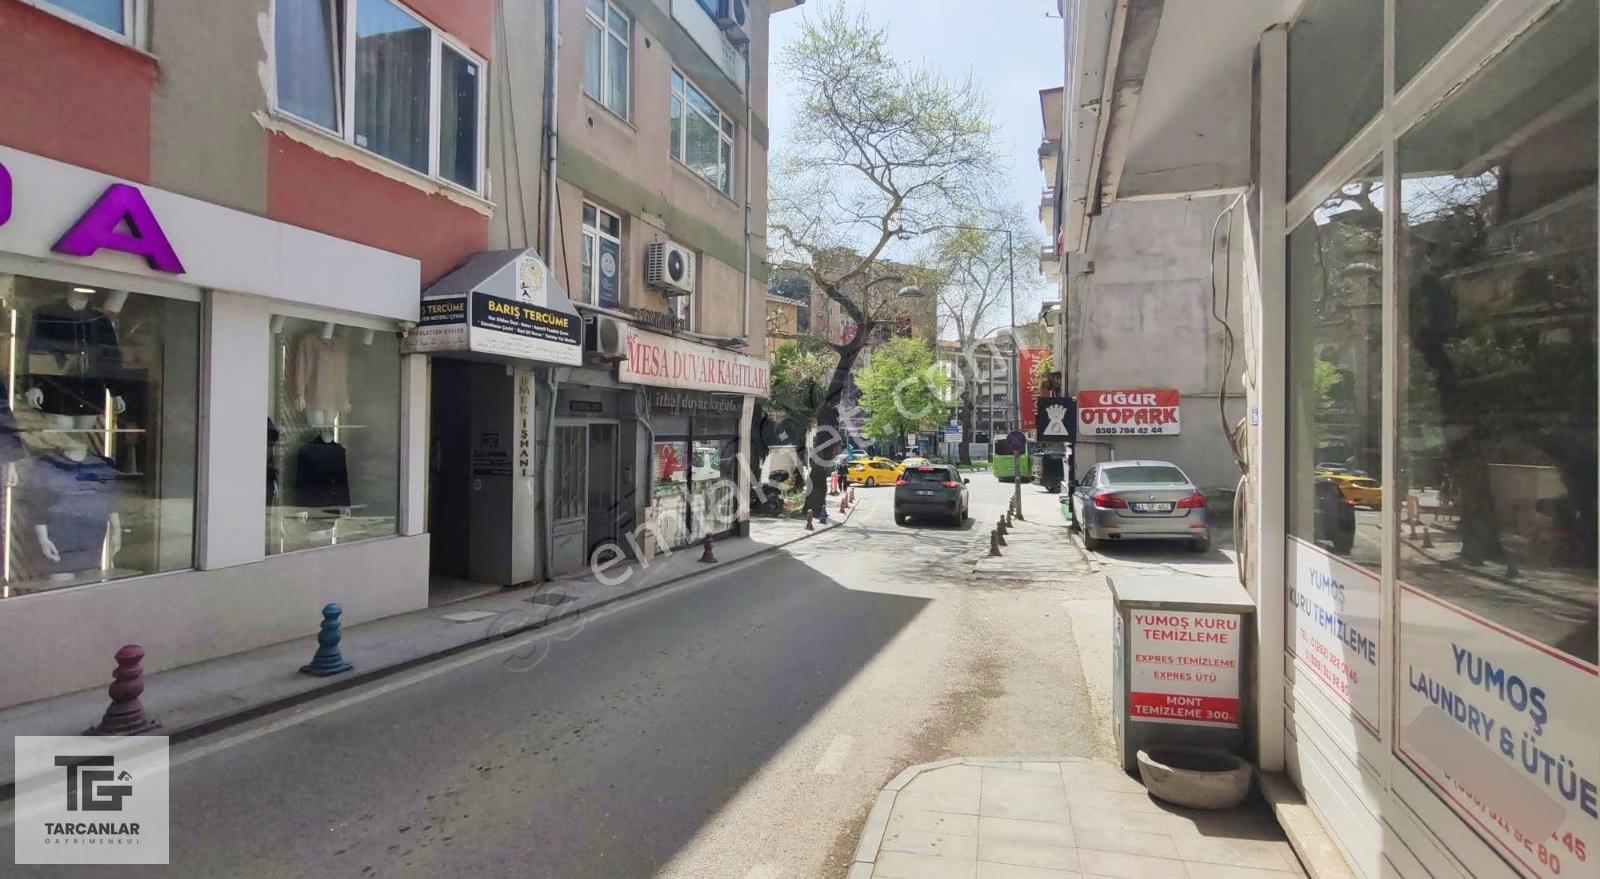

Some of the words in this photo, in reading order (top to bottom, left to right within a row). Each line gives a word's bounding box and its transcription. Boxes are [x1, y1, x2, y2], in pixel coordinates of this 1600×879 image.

[488, 300, 521, 319] BARIŞ
[522, 308, 569, 328] TERCÜME
[626, 340, 668, 379] MESA
[672, 351, 715, 384] DUVAR
[1099, 391, 1157, 406] UĞUR
[1081, 408, 1177, 425] OTOPARK
[1309, 567, 1346, 612] YUMOŞ
[1135, 615, 1189, 630] YUMOŞ
[1194, 617, 1237, 630] KURU
[1289, 585, 1312, 617] KURU
[1313, 602, 1376, 666] TEMİZLEME
[1143, 628, 1229, 643] TEMİZLEME
[1135, 654, 1174, 664] EXPRES
[1177, 655, 1236, 668] TEMİZLEME
[1153, 671, 1192, 681] EXPRES
[1195, 671, 1216, 682] ÜTÜ
[1451, 642, 1548, 737] YUMOŞ
[1135, 704, 1203, 718] TEMİZLEME
[1166, 695, 1203, 707] MONT
[1409, 665, 1495, 743] LAUNDRY
[1500, 726, 1514, 760] &
[1521, 730, 1598, 820] ÜTÜE
[1562, 831, 1587, 863] 45
[1537, 843, 1561, 876] 80
